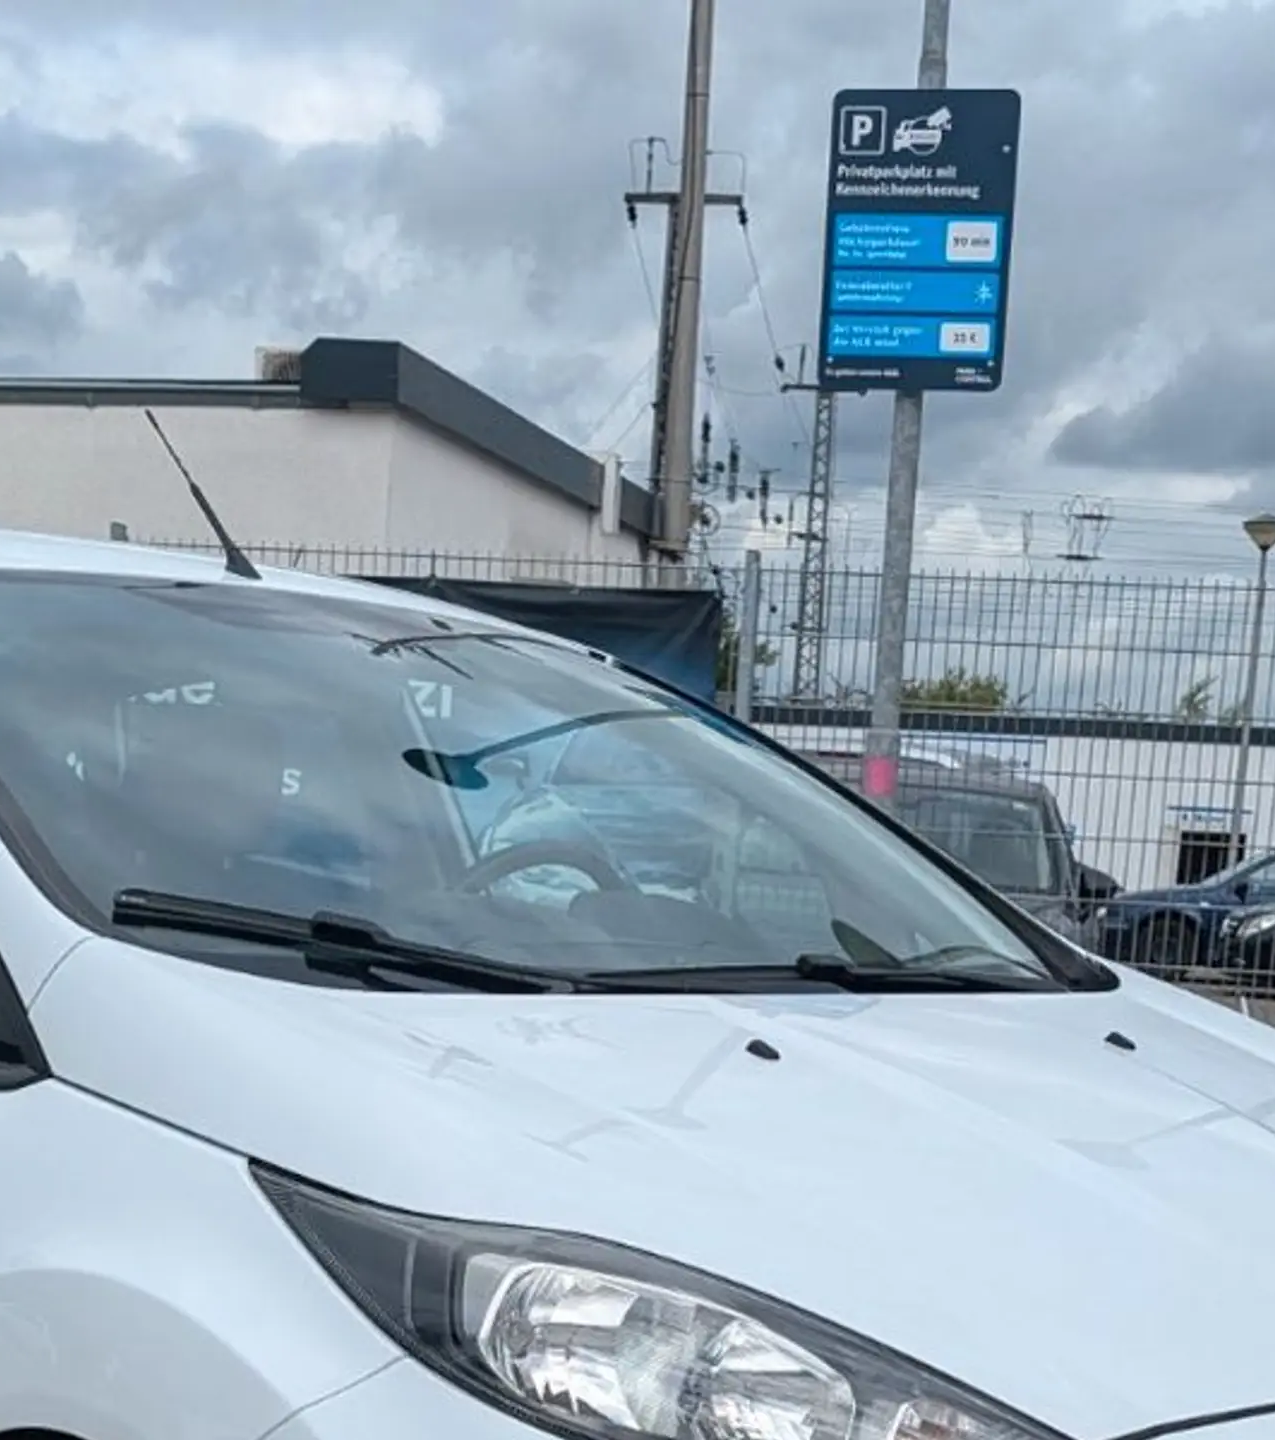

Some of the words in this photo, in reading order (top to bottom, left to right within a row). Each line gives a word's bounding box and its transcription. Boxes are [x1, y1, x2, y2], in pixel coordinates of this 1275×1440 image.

[852, 115, 874, 147] P
[837, 164, 932, 180] Privatparkplatz
[936, 165, 957, 179] mit
[835, 181, 981, 200] Kennzeichenerkennung
